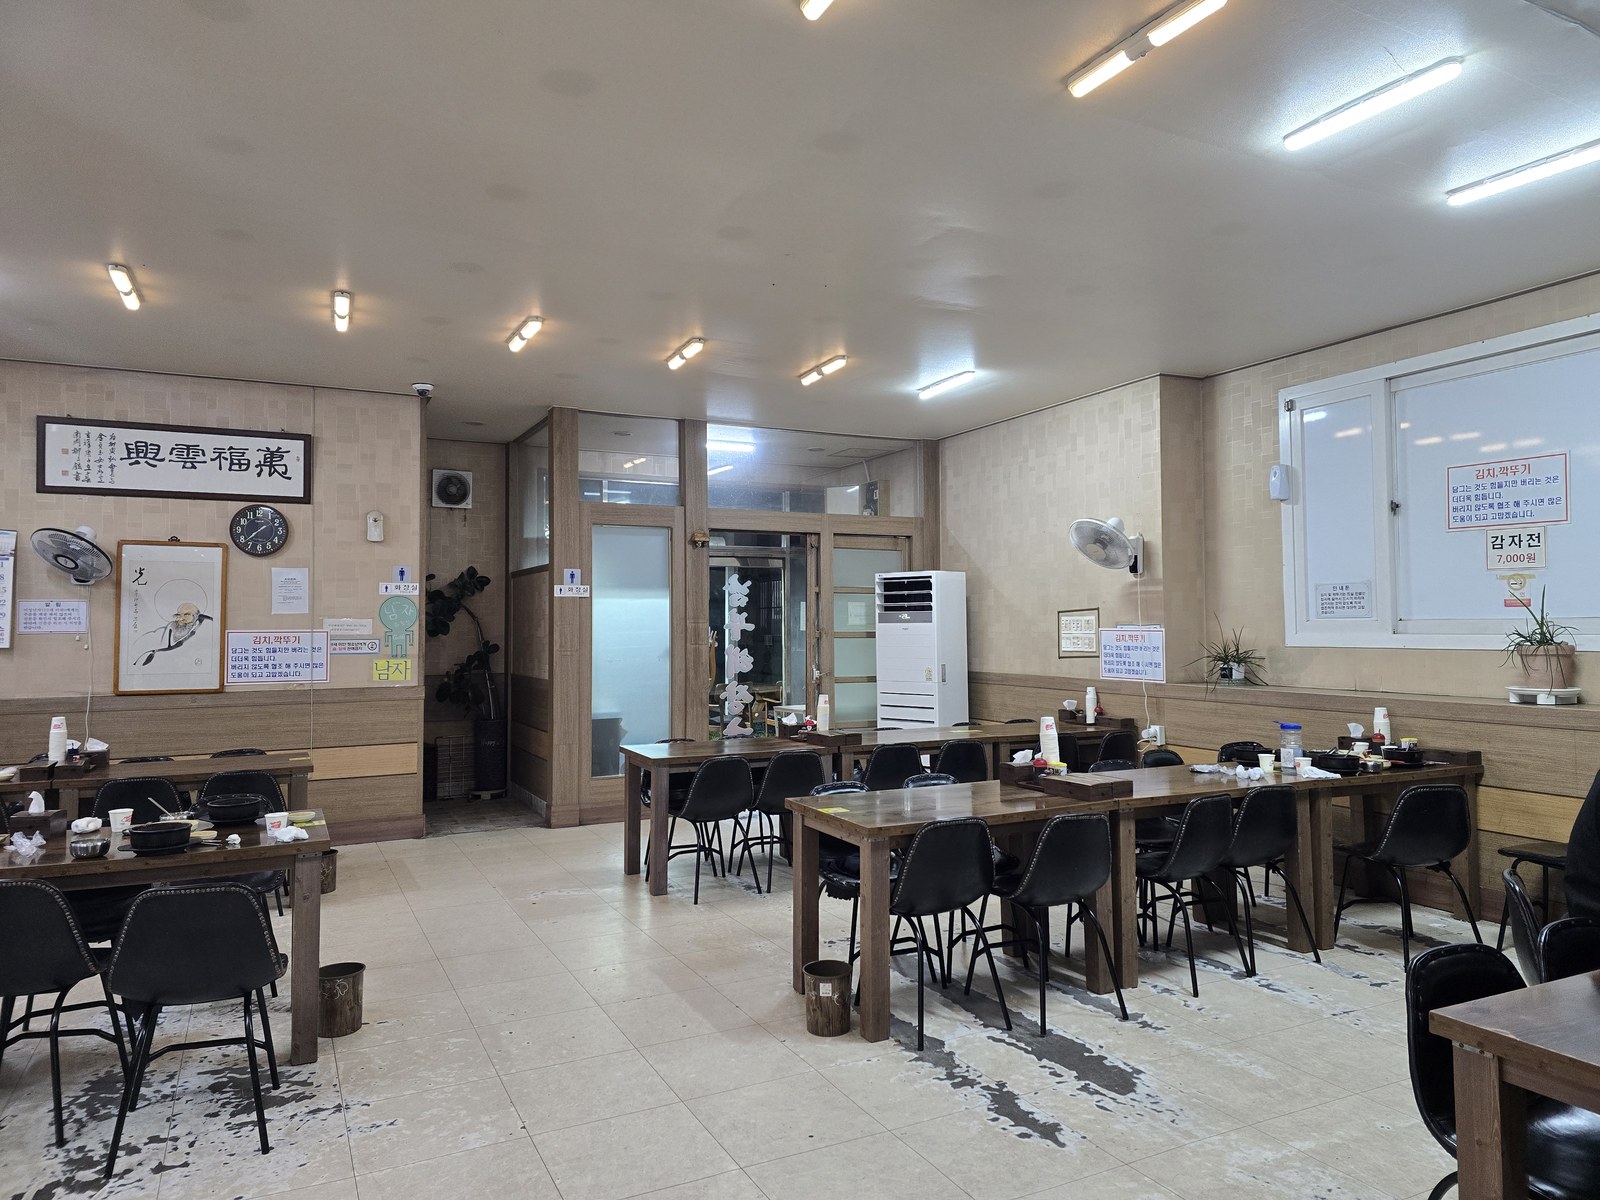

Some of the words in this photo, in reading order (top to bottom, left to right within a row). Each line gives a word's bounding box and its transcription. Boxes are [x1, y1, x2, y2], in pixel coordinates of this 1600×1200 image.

[1475, 483, 1487, 491] 것도
[1490, 480, 1518, 490] 힘들지만
[1520, 478, 1541, 486] 버리는
[1545, 475, 1560, 484] 것은
[1452, 495, 1472, 503] 더더욱
[1475, 492, 1504, 501] 힘듭니다.
[1452, 505, 1472, 513] 버리지
[1475, 503, 1495, 511] 않도록
[1497, 501, 1511, 510] 협조
[1513, 500, 1520, 508] 해
[1523, 498, 1545, 507] 주시면
[1548, 496, 1562, 505] 많은
[1452, 515, 1472, 523] 도움이
[1475, 513, 1488, 521] 되고
[1491, 510, 1535, 520] 고맙겠습니다.
[273, 536, 278, 544] 4
[1491, 533, 1541, 550] 감자전
[1497, 553, 1536, 564] 7,000원
[384, 604, 414, 620] 남자
[375, 661, 411, 680] 남자
